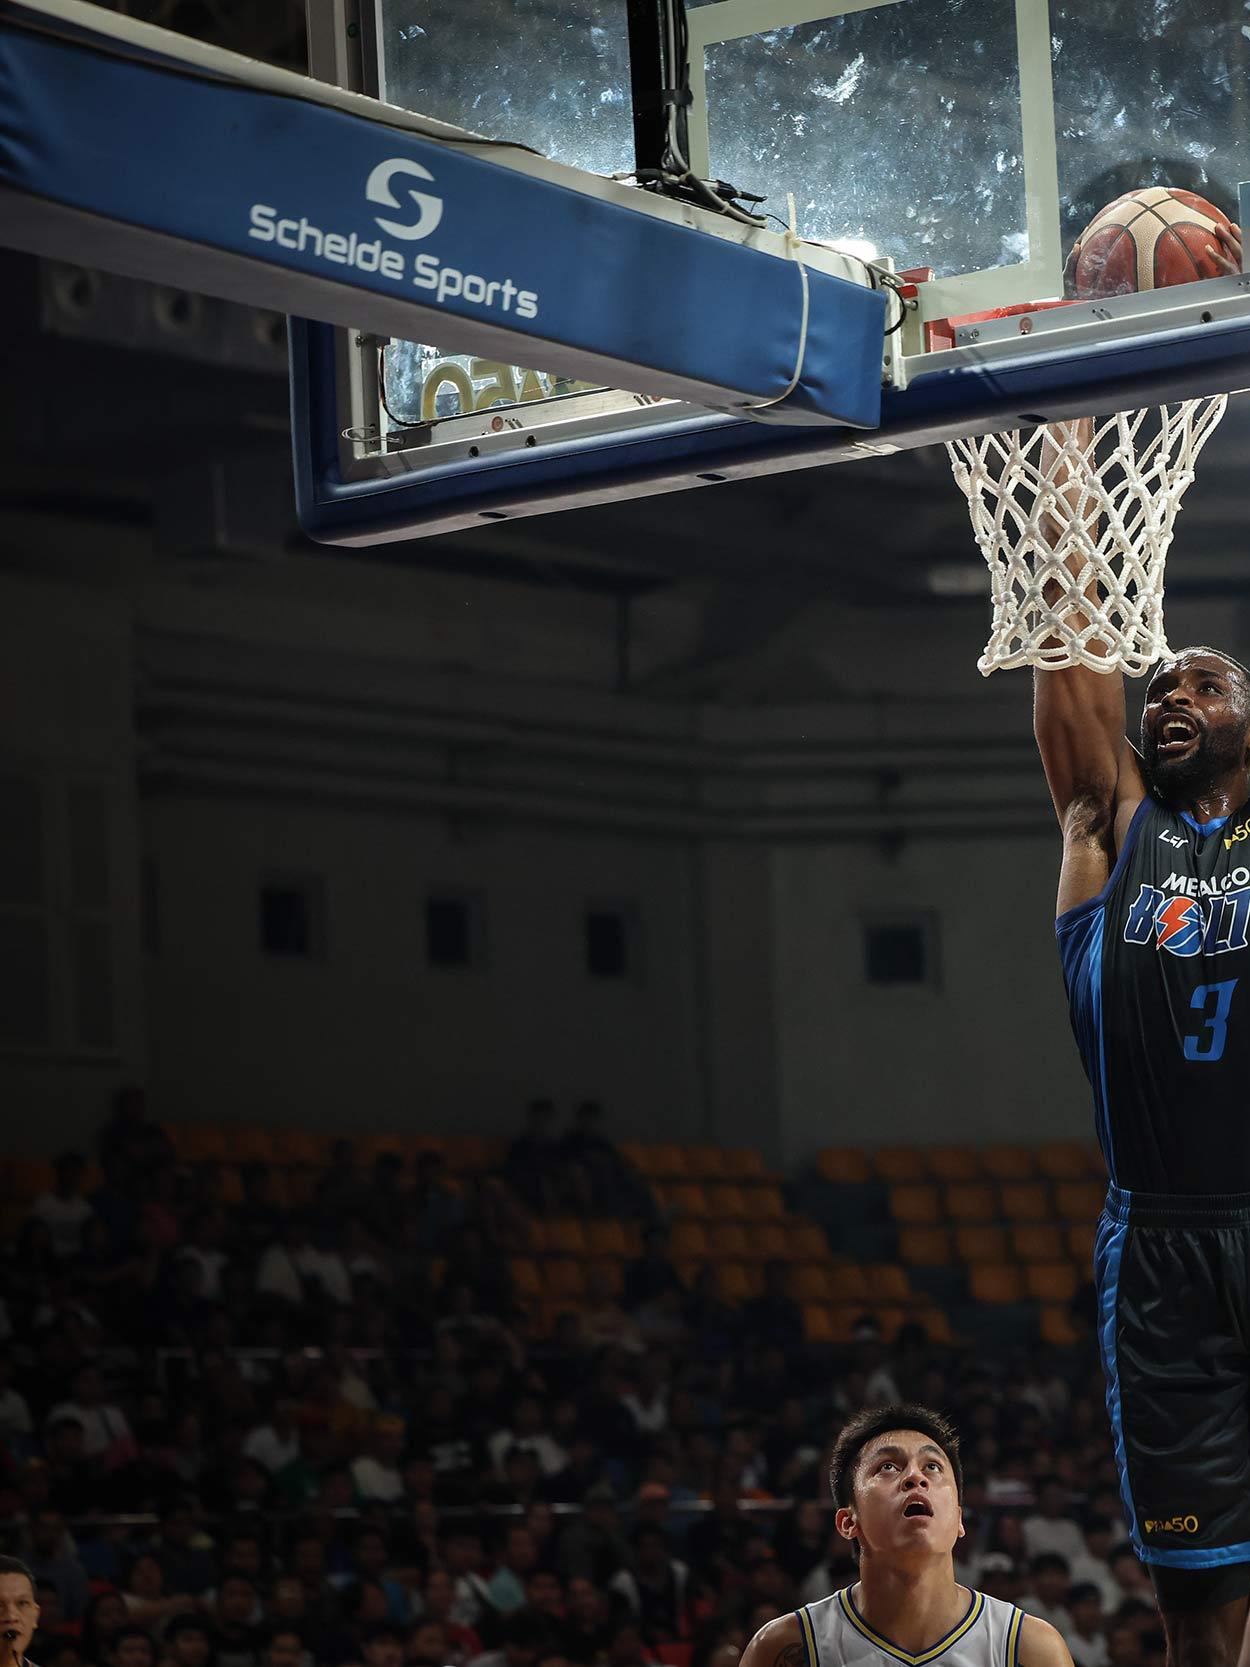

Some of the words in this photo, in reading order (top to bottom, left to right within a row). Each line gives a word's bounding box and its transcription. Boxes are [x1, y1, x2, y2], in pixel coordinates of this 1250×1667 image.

[249, 203, 404, 280] Schelde
[413, 253, 538, 319] Sports
[1161, 867, 1250, 898] MEALCO
[1183, 978, 1239, 1062] 3
